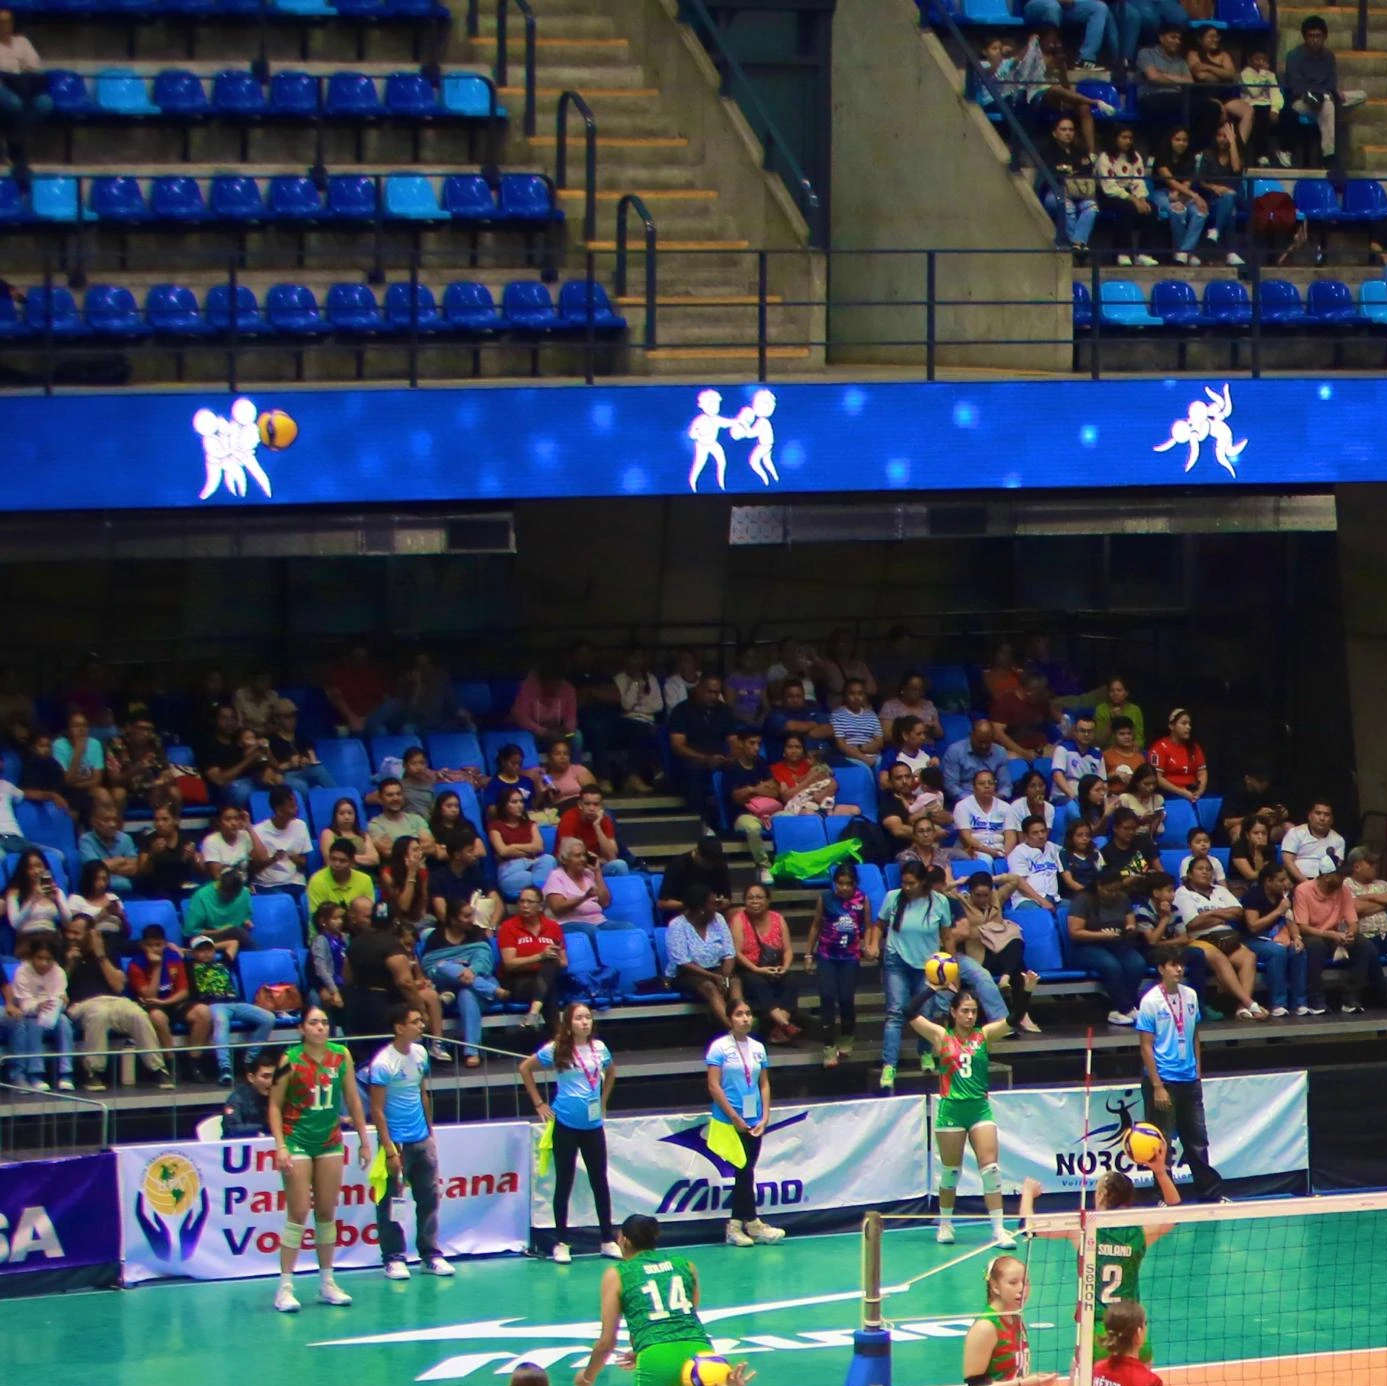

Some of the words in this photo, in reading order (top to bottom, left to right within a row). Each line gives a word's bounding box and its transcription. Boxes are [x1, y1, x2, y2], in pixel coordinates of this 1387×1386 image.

[958, 1053, 972, 1078] 3
[309, 1084, 334, 1110] 11
[641, 1275, 694, 1321] 14
[1084, 1263, 1095, 1311] Senoh
[1100, 1264, 1123, 1304] 2
